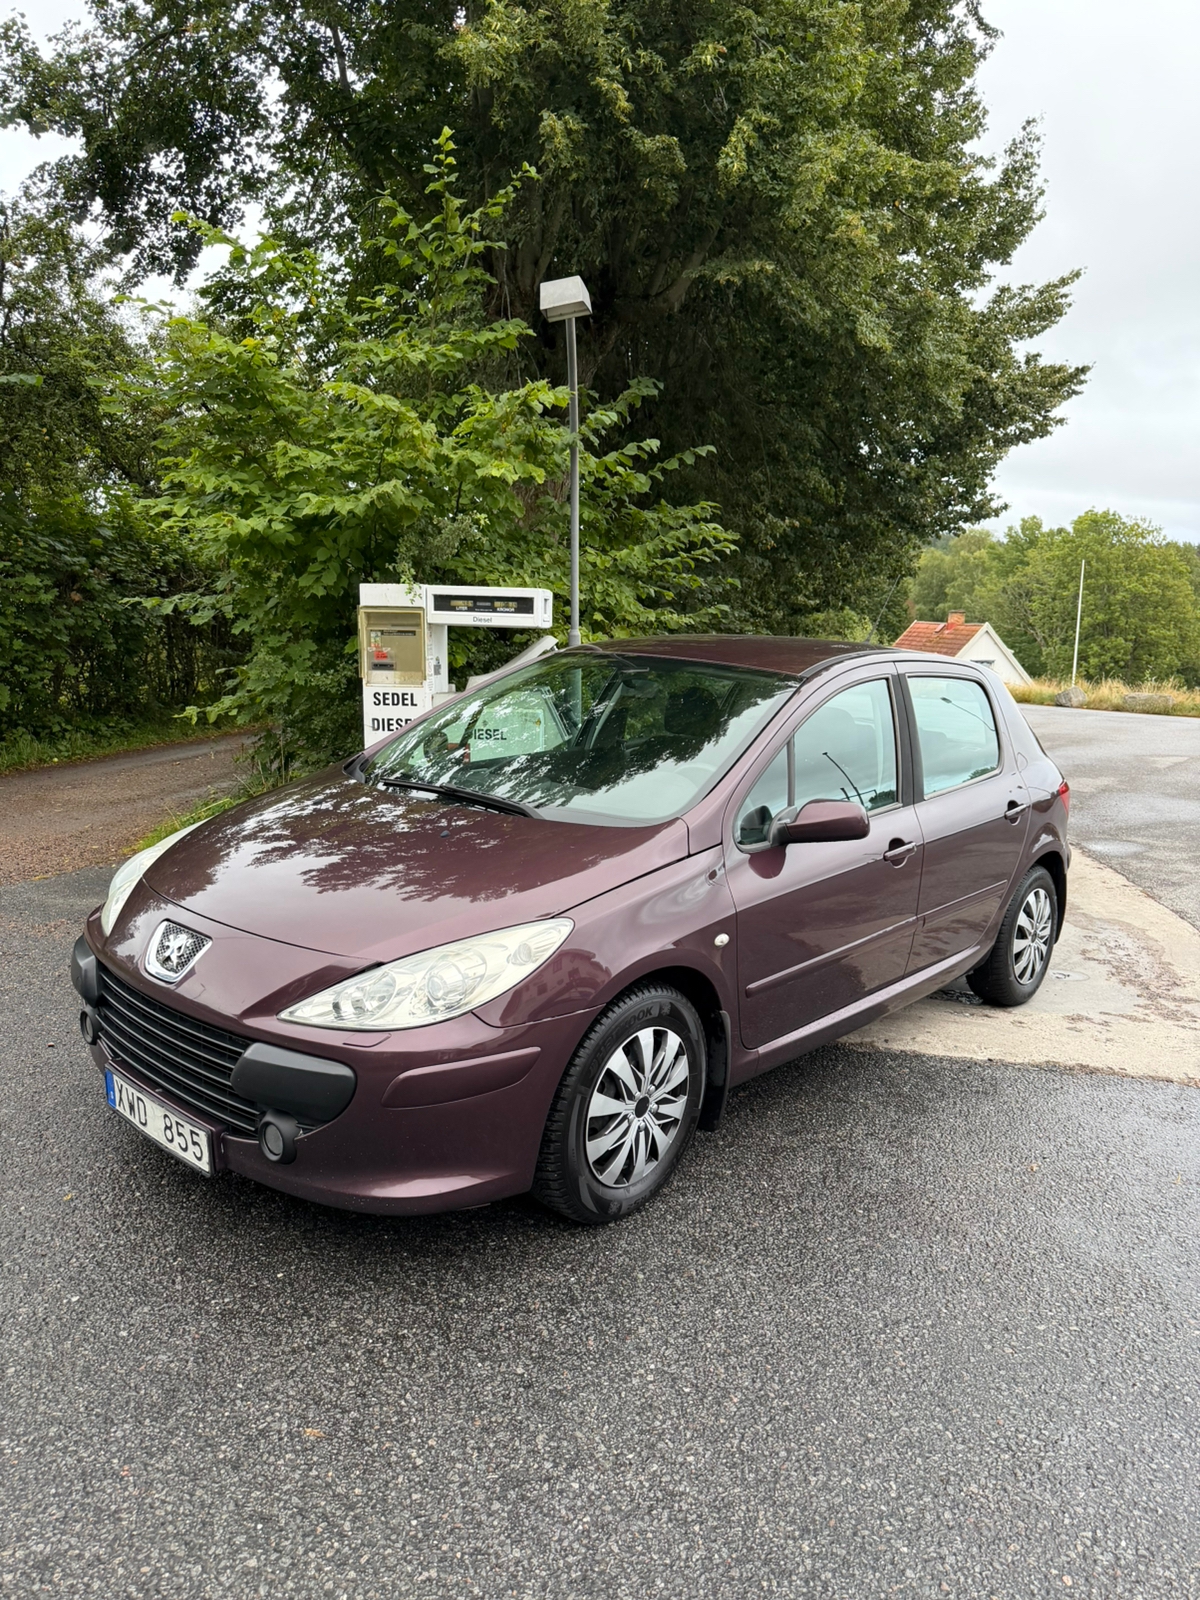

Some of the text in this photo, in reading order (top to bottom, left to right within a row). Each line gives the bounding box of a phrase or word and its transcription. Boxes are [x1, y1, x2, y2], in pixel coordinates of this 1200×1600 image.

[472, 616, 493, 624] Diesel
[373, 691, 418, 707] SEDEL
[371, 718, 414, 732] DIES
[472, 728, 507, 741] IESEL
[115, 1078, 204, 1162] XWD 855
